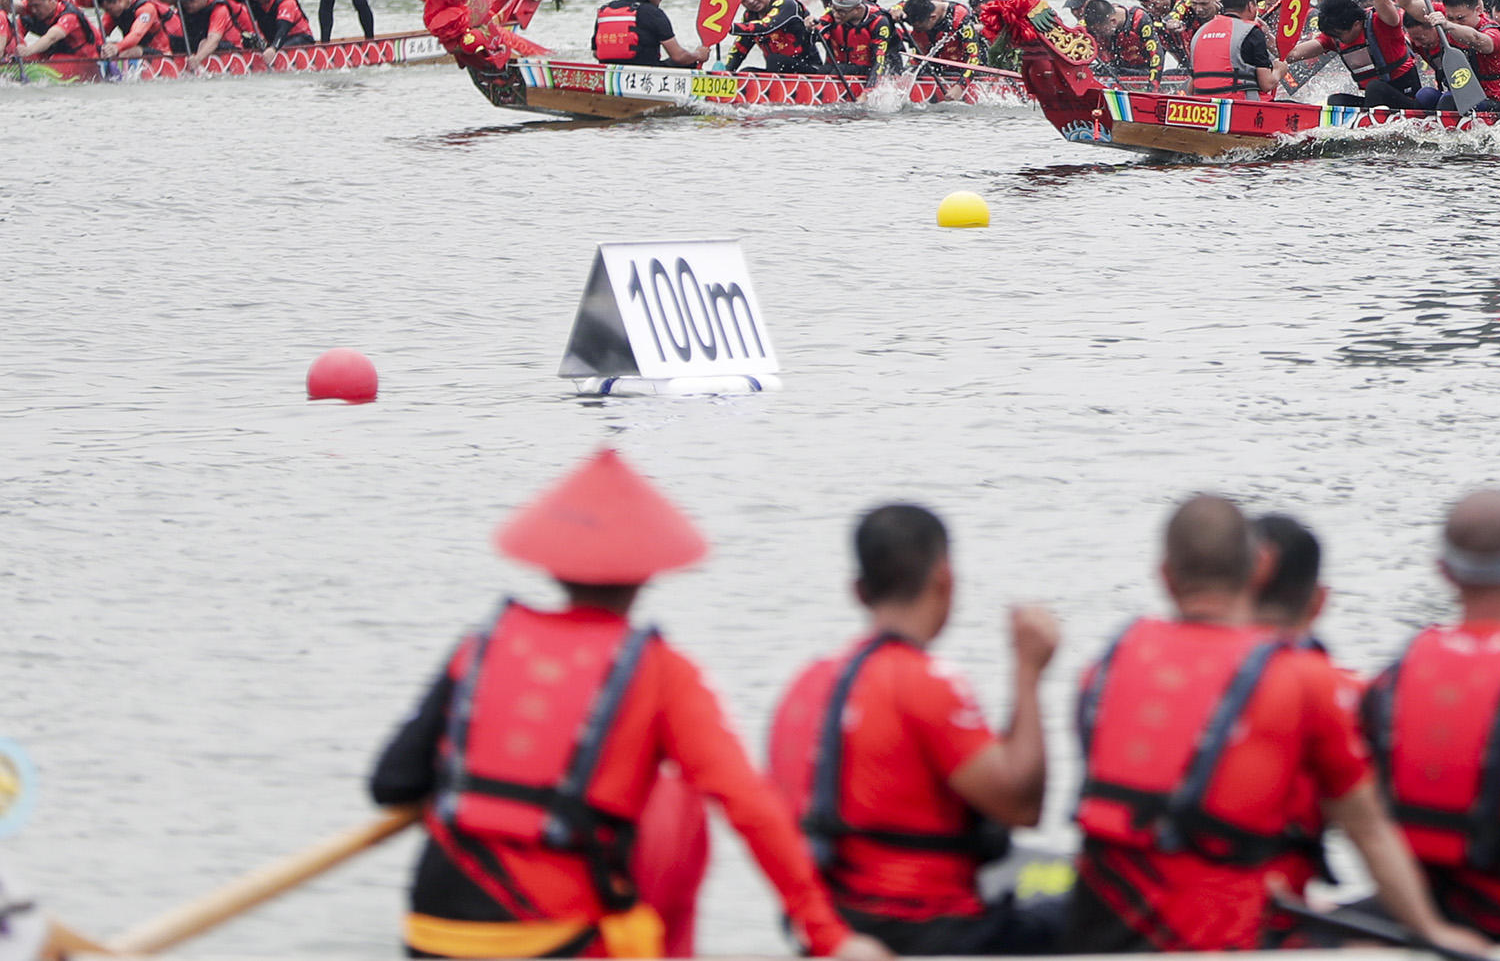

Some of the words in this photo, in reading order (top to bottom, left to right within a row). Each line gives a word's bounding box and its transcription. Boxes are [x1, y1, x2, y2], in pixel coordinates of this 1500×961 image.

[692, 77, 736, 95] 213042
[1168, 103, 1216, 124] 211035
[628, 256, 766, 362] 100m
